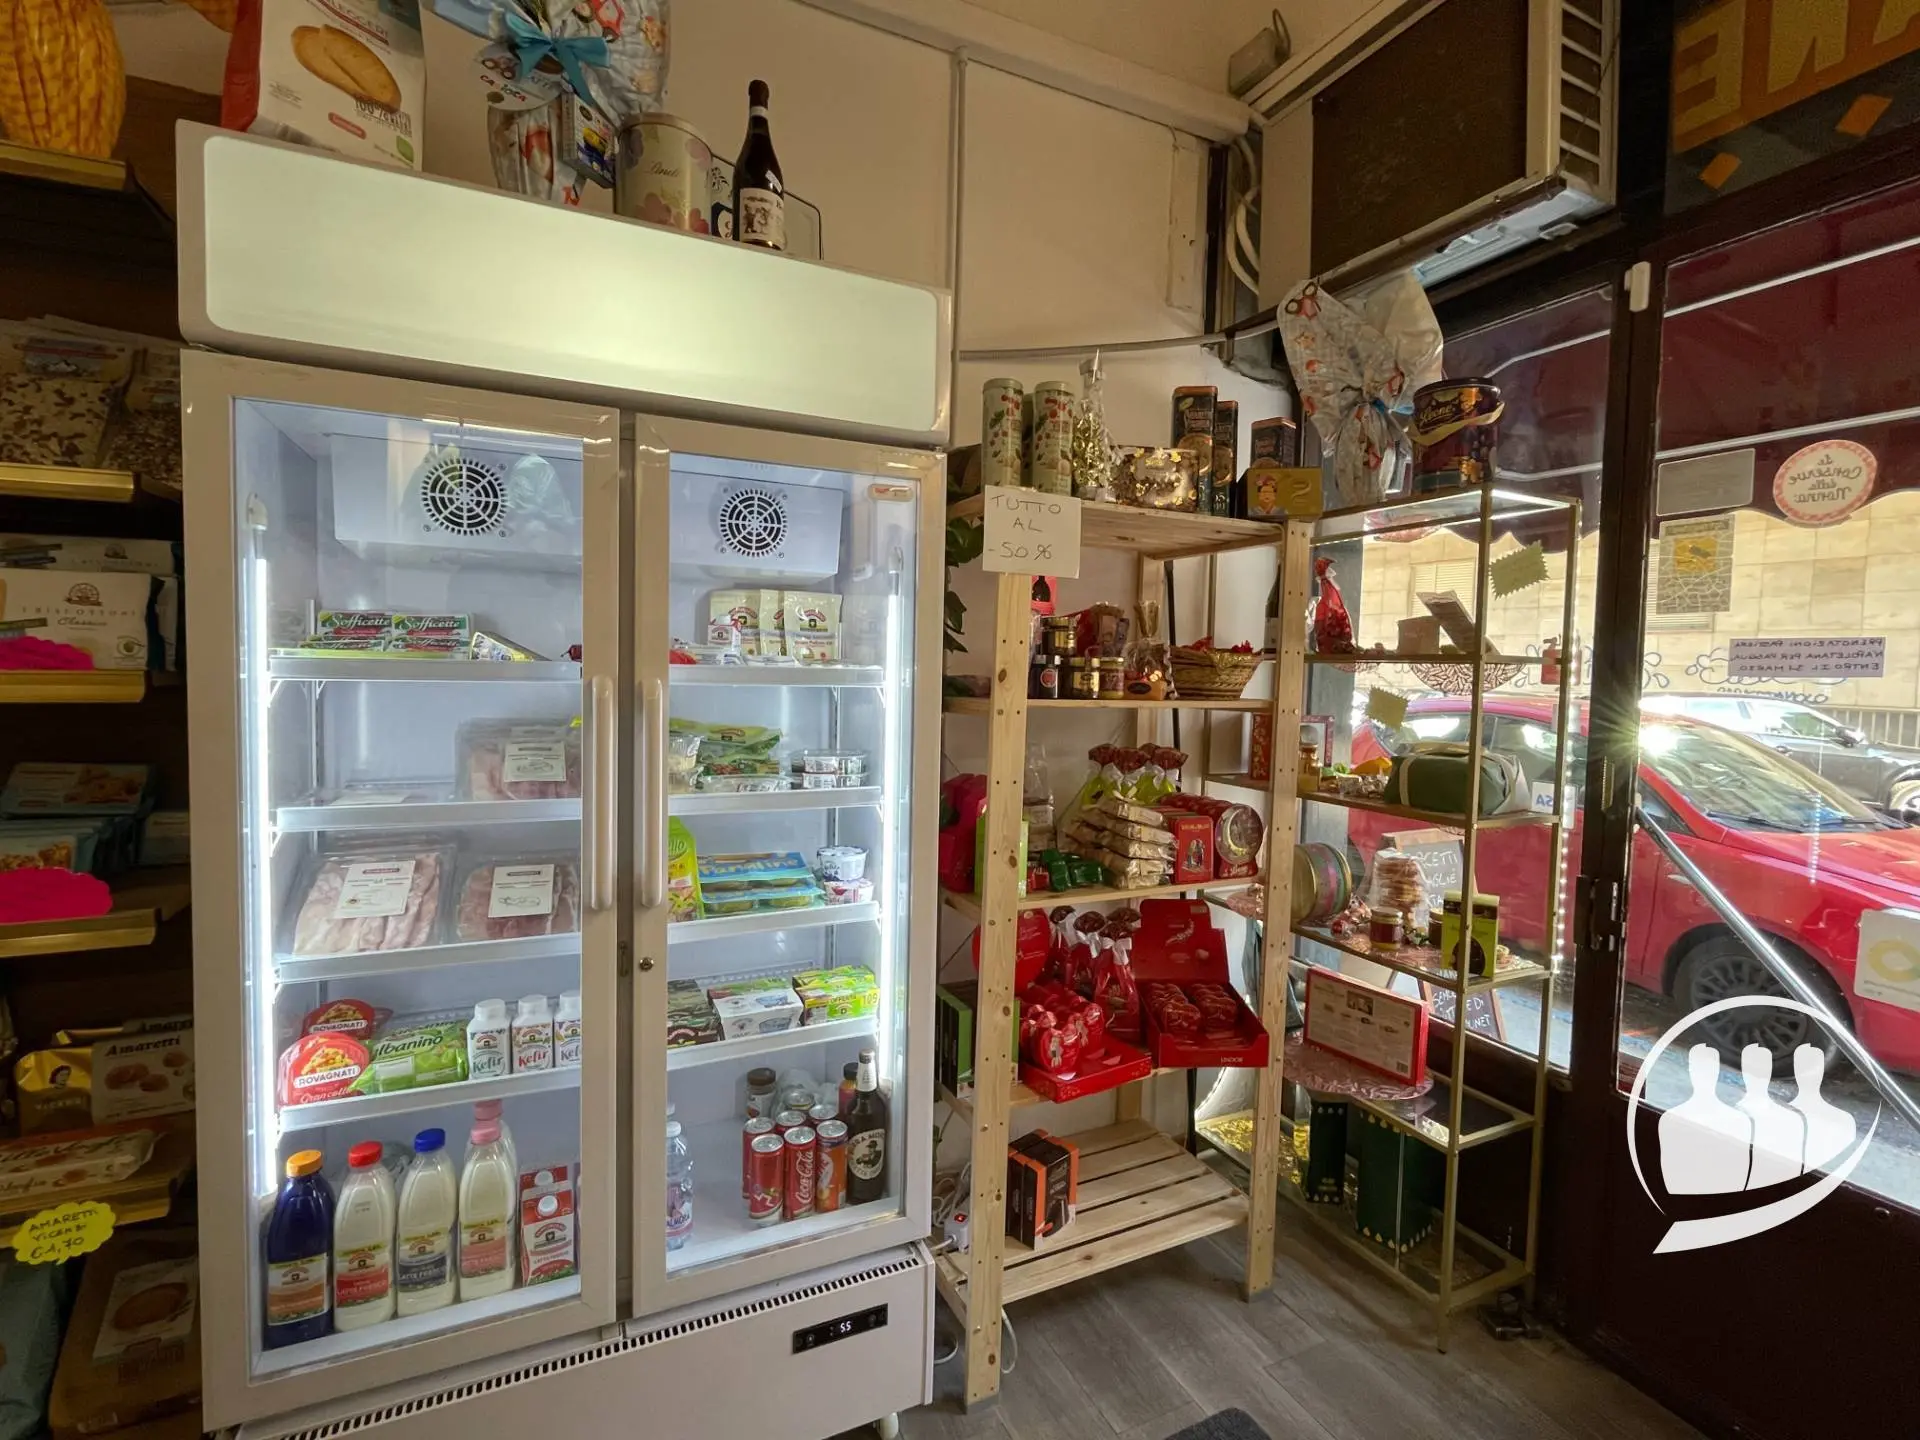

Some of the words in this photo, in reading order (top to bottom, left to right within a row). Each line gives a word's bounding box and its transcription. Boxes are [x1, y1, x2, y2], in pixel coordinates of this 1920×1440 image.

[990, 493, 1063, 516] TUTTO
[1012, 515, 1044, 534] AL
[326, 613, 391, 630] Sofficette
[398, 614, 461, 631] Sofficette
[374, 1031, 444, 1057] albanino
[472, 1056, 504, 1073] Kefir
[518, 1050, 549, 1067] Kefir
[298, 1067, 357, 1087] ROVAGNATI
